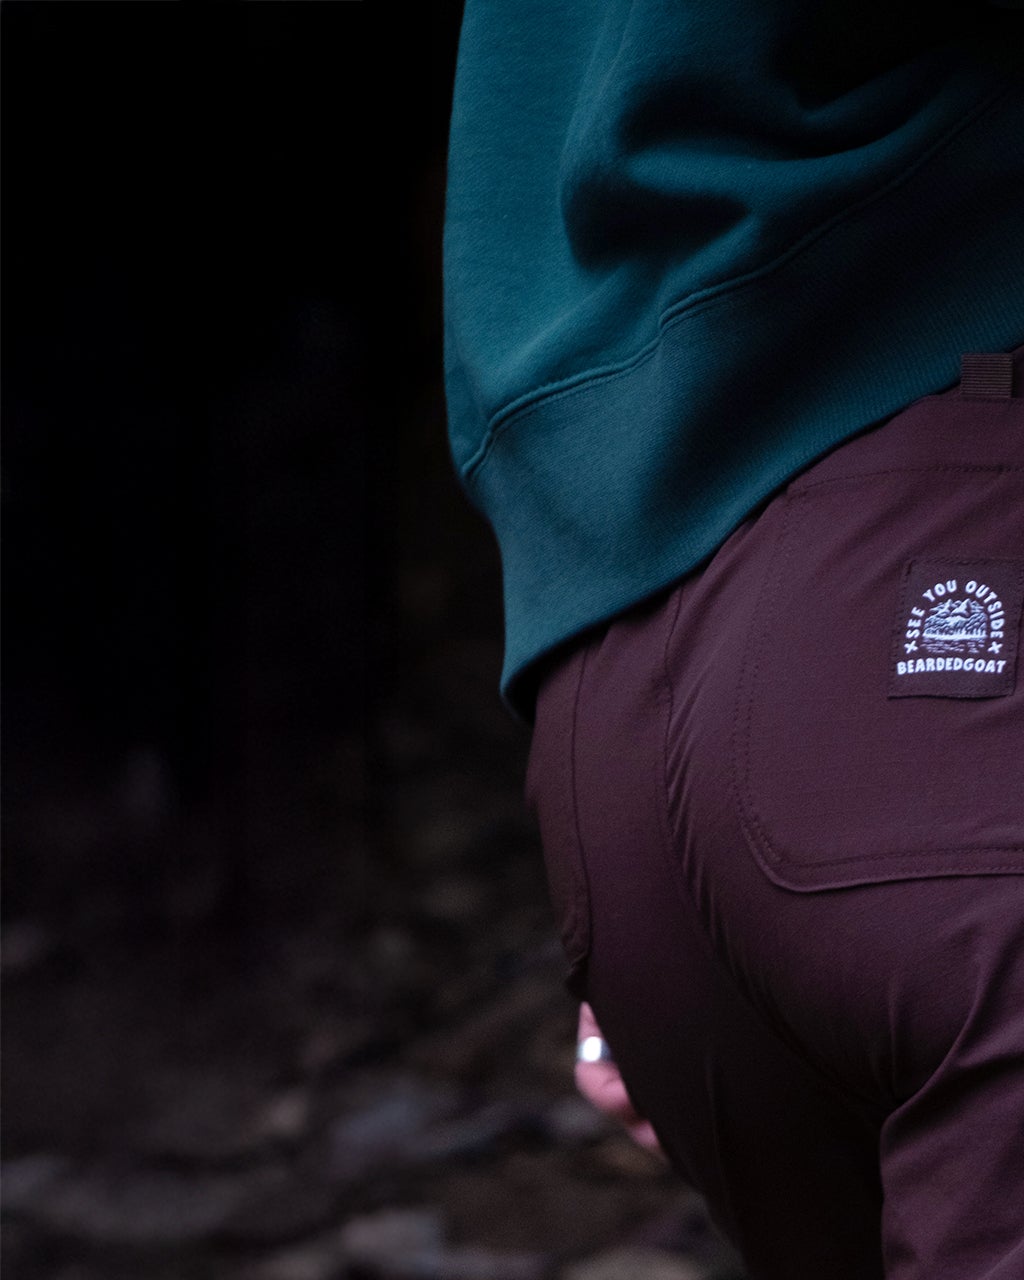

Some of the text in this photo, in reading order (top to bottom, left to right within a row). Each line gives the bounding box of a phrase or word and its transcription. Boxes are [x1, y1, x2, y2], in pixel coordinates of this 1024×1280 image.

[906, 580, 1005, 638] SEE YOU OUTSIDE
[897, 657, 1006, 675] BEARDEDGOAT
